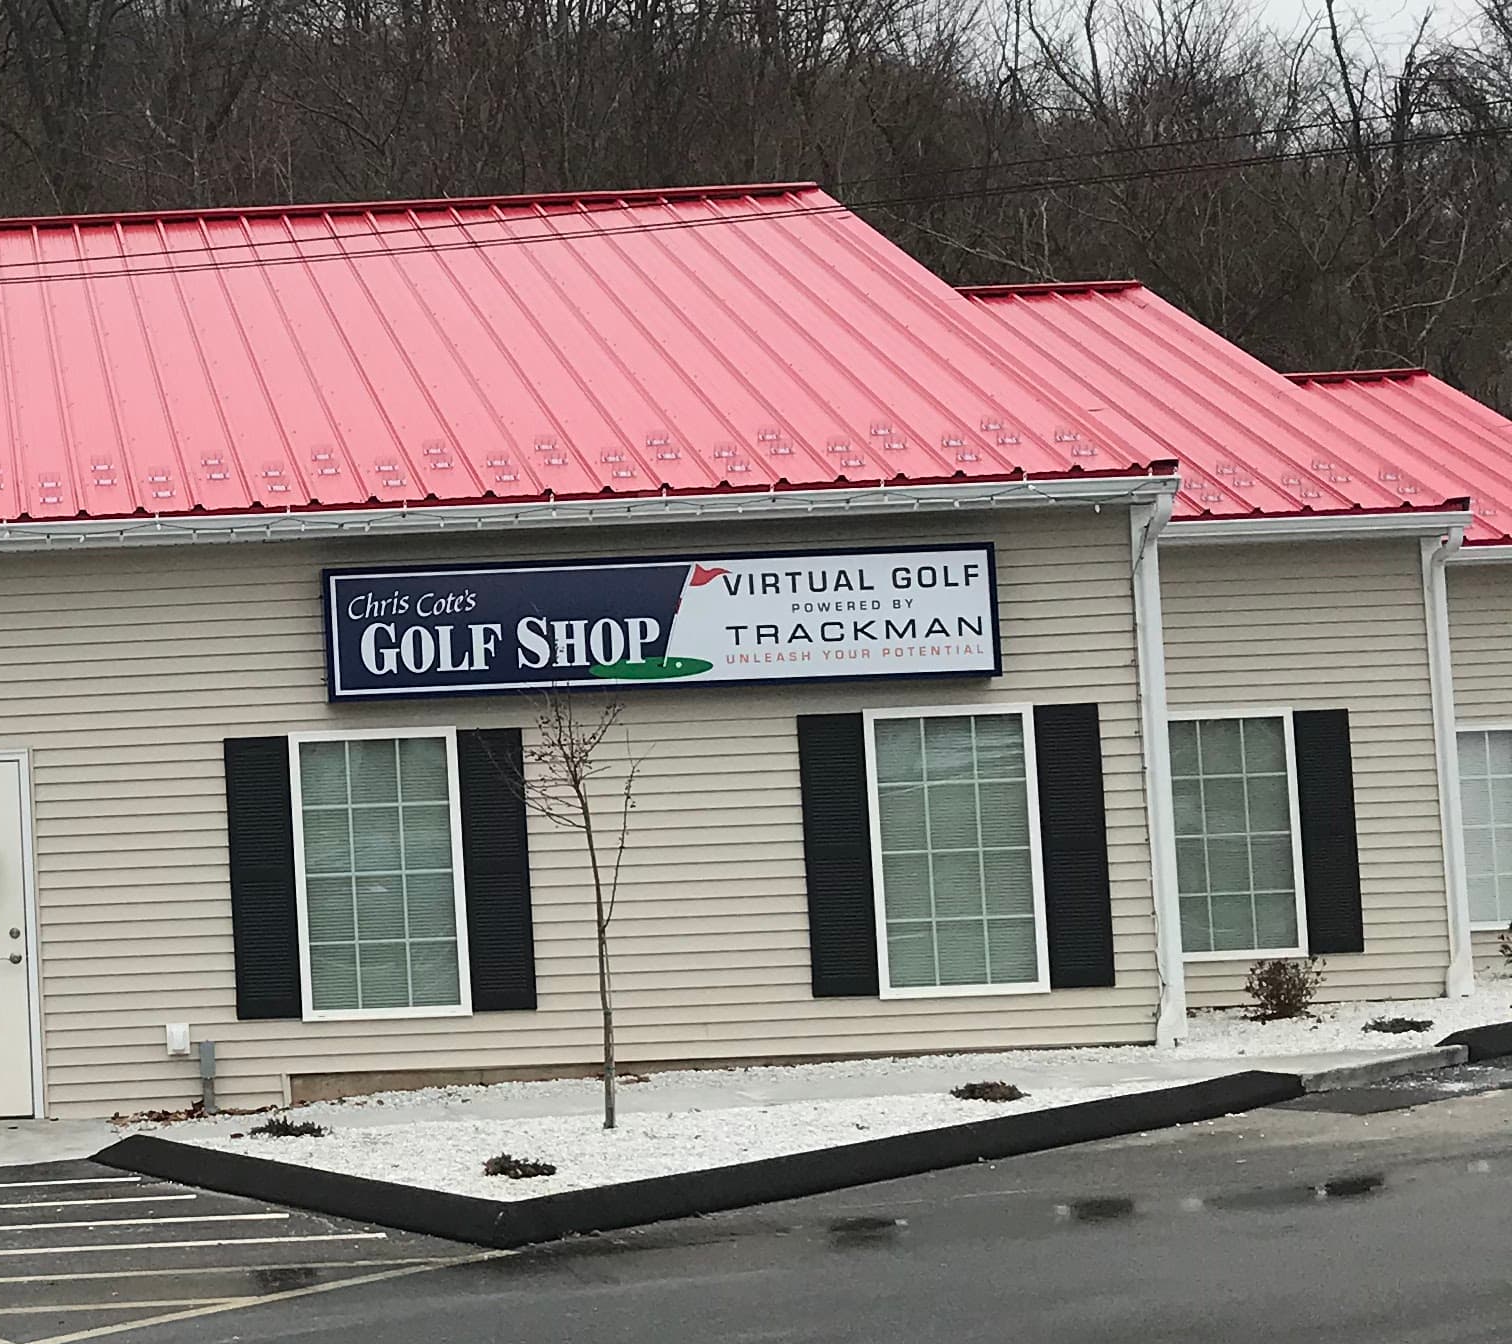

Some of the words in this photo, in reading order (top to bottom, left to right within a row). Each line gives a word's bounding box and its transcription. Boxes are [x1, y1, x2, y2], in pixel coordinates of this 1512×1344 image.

[722, 568, 875, 596] VIRTUAL
[892, 564, 979, 590] GOLF
[348, 590, 410, 620] Chris
[416, 589, 476, 617] Cote's
[791, 600, 881, 613] POWERED
[892, 598, 914, 609] BY
[360, 622, 503, 676] GOLF
[516, 616, 660, 669] SHOP
[725, 616, 983, 646] TRACKMAN
[726, 651, 811, 665] UNLEASH
[823, 648, 870, 660] YOUR
[882, 644, 984, 657] POTENTIAL
